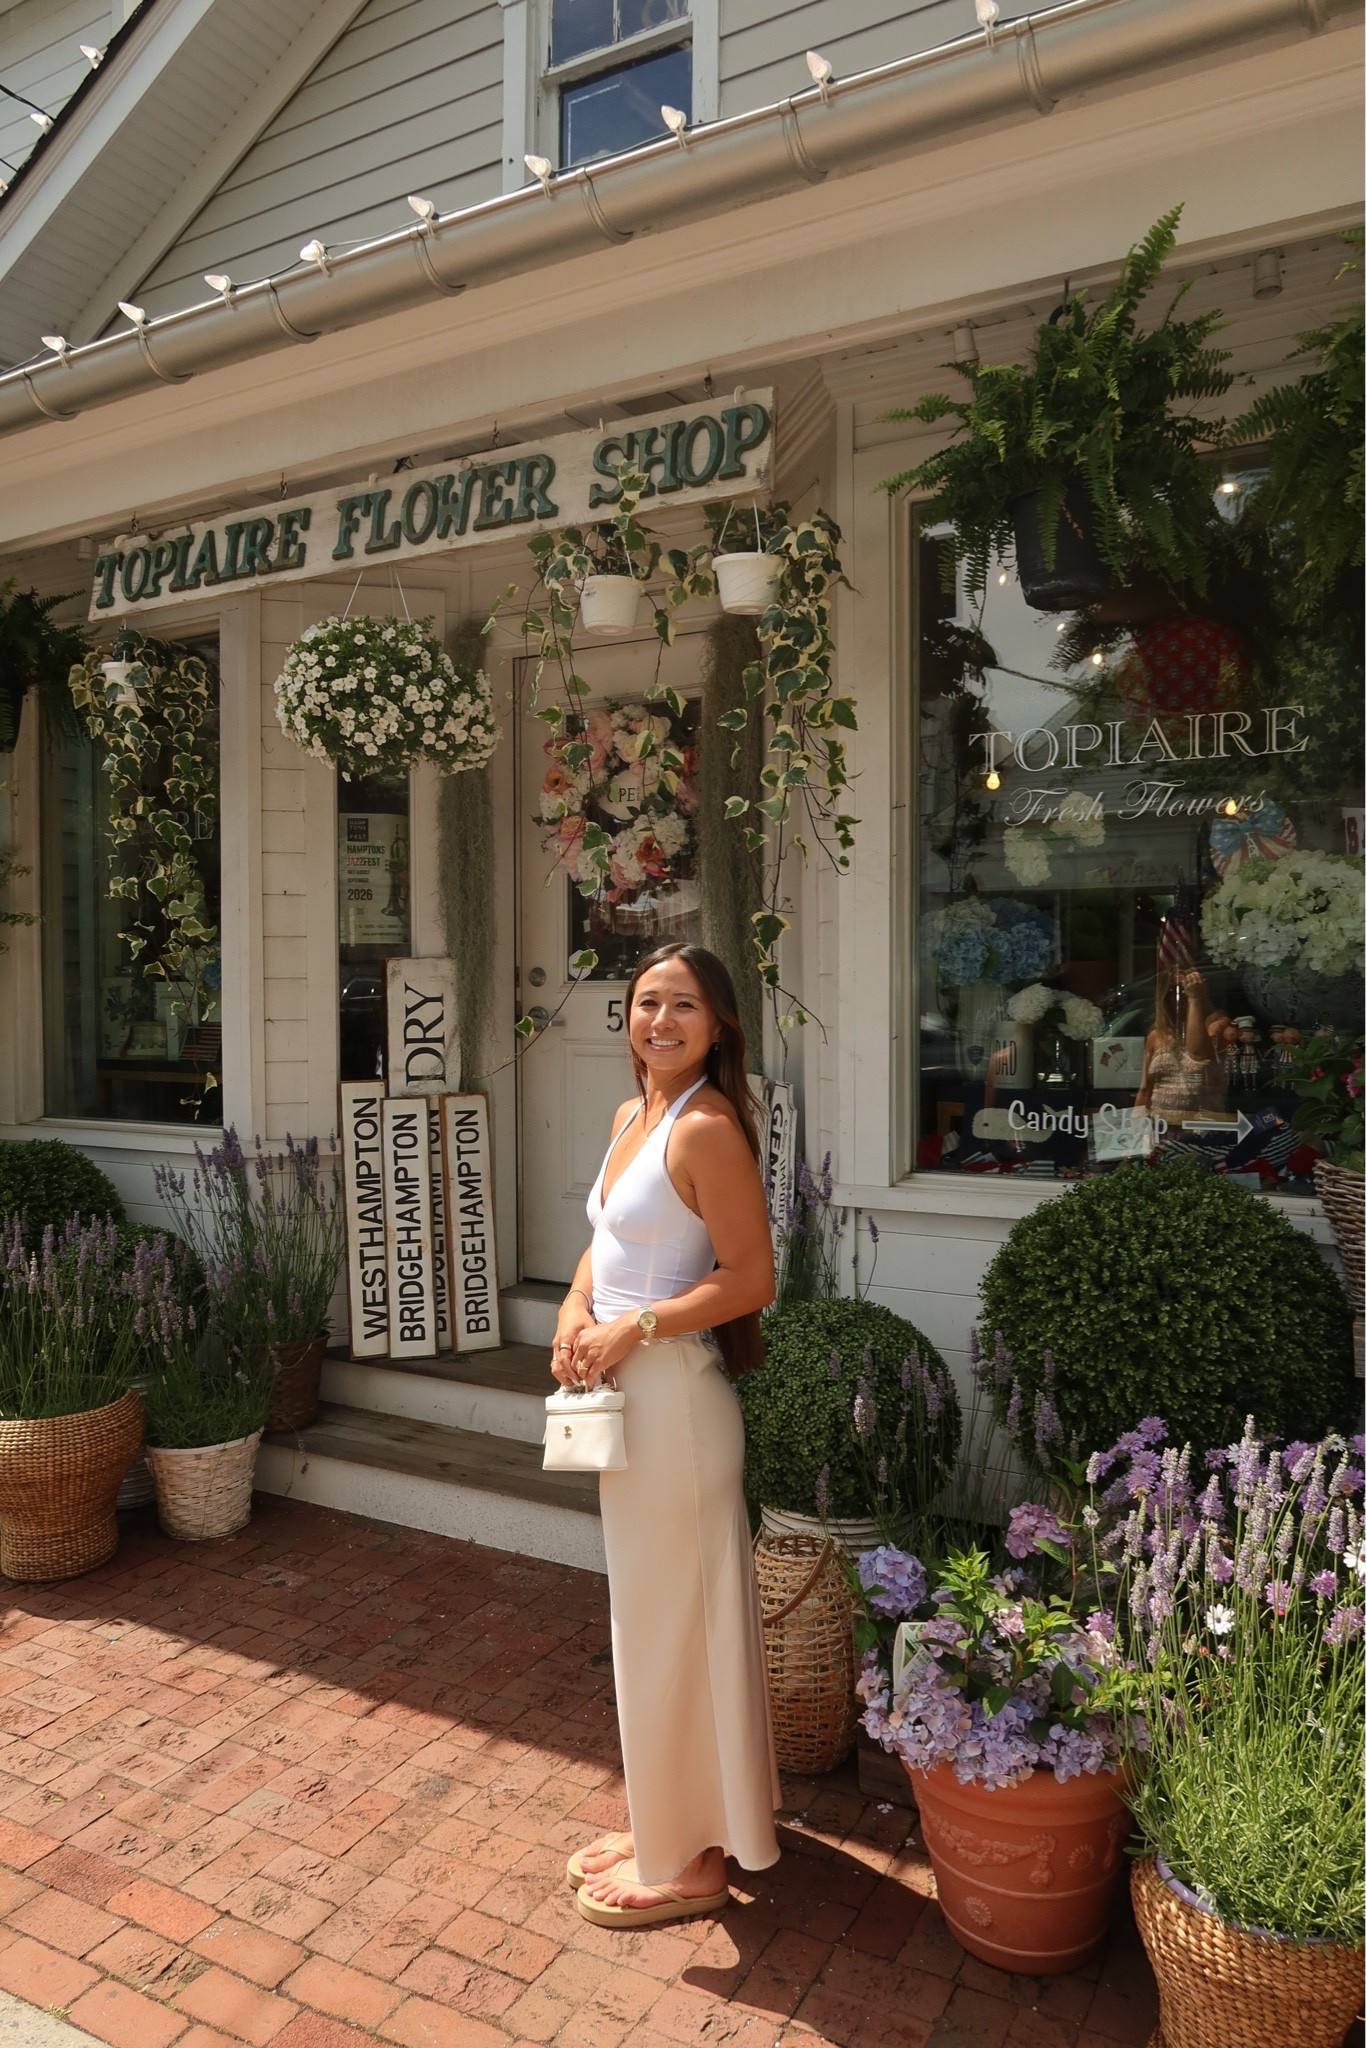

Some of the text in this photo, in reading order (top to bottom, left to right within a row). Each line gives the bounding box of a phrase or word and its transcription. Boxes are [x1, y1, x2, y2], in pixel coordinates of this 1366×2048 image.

[94, 402, 771, 608] TOPIAIRE FLOWER SHOP
[968, 705, 1310, 775] TOPIAIRE
[1004, 779, 1266, 826] Fresh Flowers
[347, 845, 386, 854] HAMPTONS
[347, 857, 381, 867] JAZZFEST
[347, 888, 373, 900] 2026
[403, 981, 446, 1087] DRY
[606, 1000, 623, 1033] 5
[995, 1040, 1017, 1076] DAD
[1008, 1099, 1089, 1139] Candy
[1099, 1102, 1168, 1144] Shop
[352, 1097, 388, 1340] WESTHAMPTON
[392, 1113, 426, 1342] BRIDGEHAMPTON
[455, 1109, 491, 1334] BRIDGEHAMPTON
